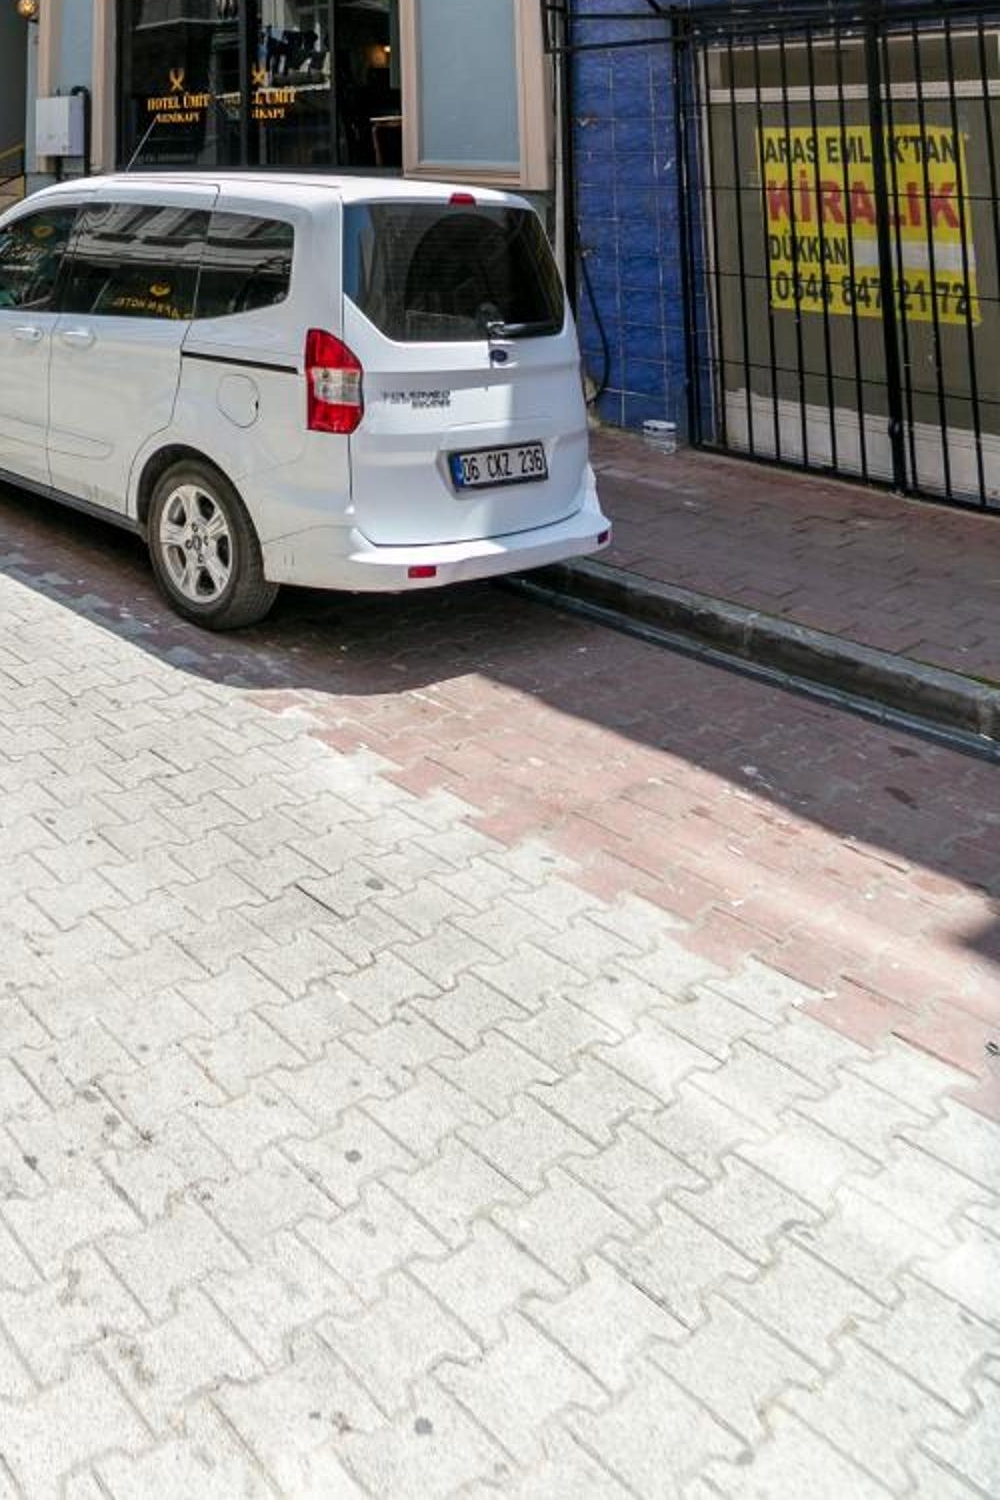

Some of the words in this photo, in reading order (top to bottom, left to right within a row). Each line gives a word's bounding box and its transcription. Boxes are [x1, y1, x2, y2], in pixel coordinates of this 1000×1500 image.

[147, 97, 180, 111] HOTEL
[765, 136, 817, 163] ARAS
[825, 134, 957, 164] EMLK'TAN
[769, 231, 848, 265] DÜKKAN
[463, 457, 481, 481] 06
[487, 451, 512, 479] CKZ
[517, 449, 544, 474] 236
